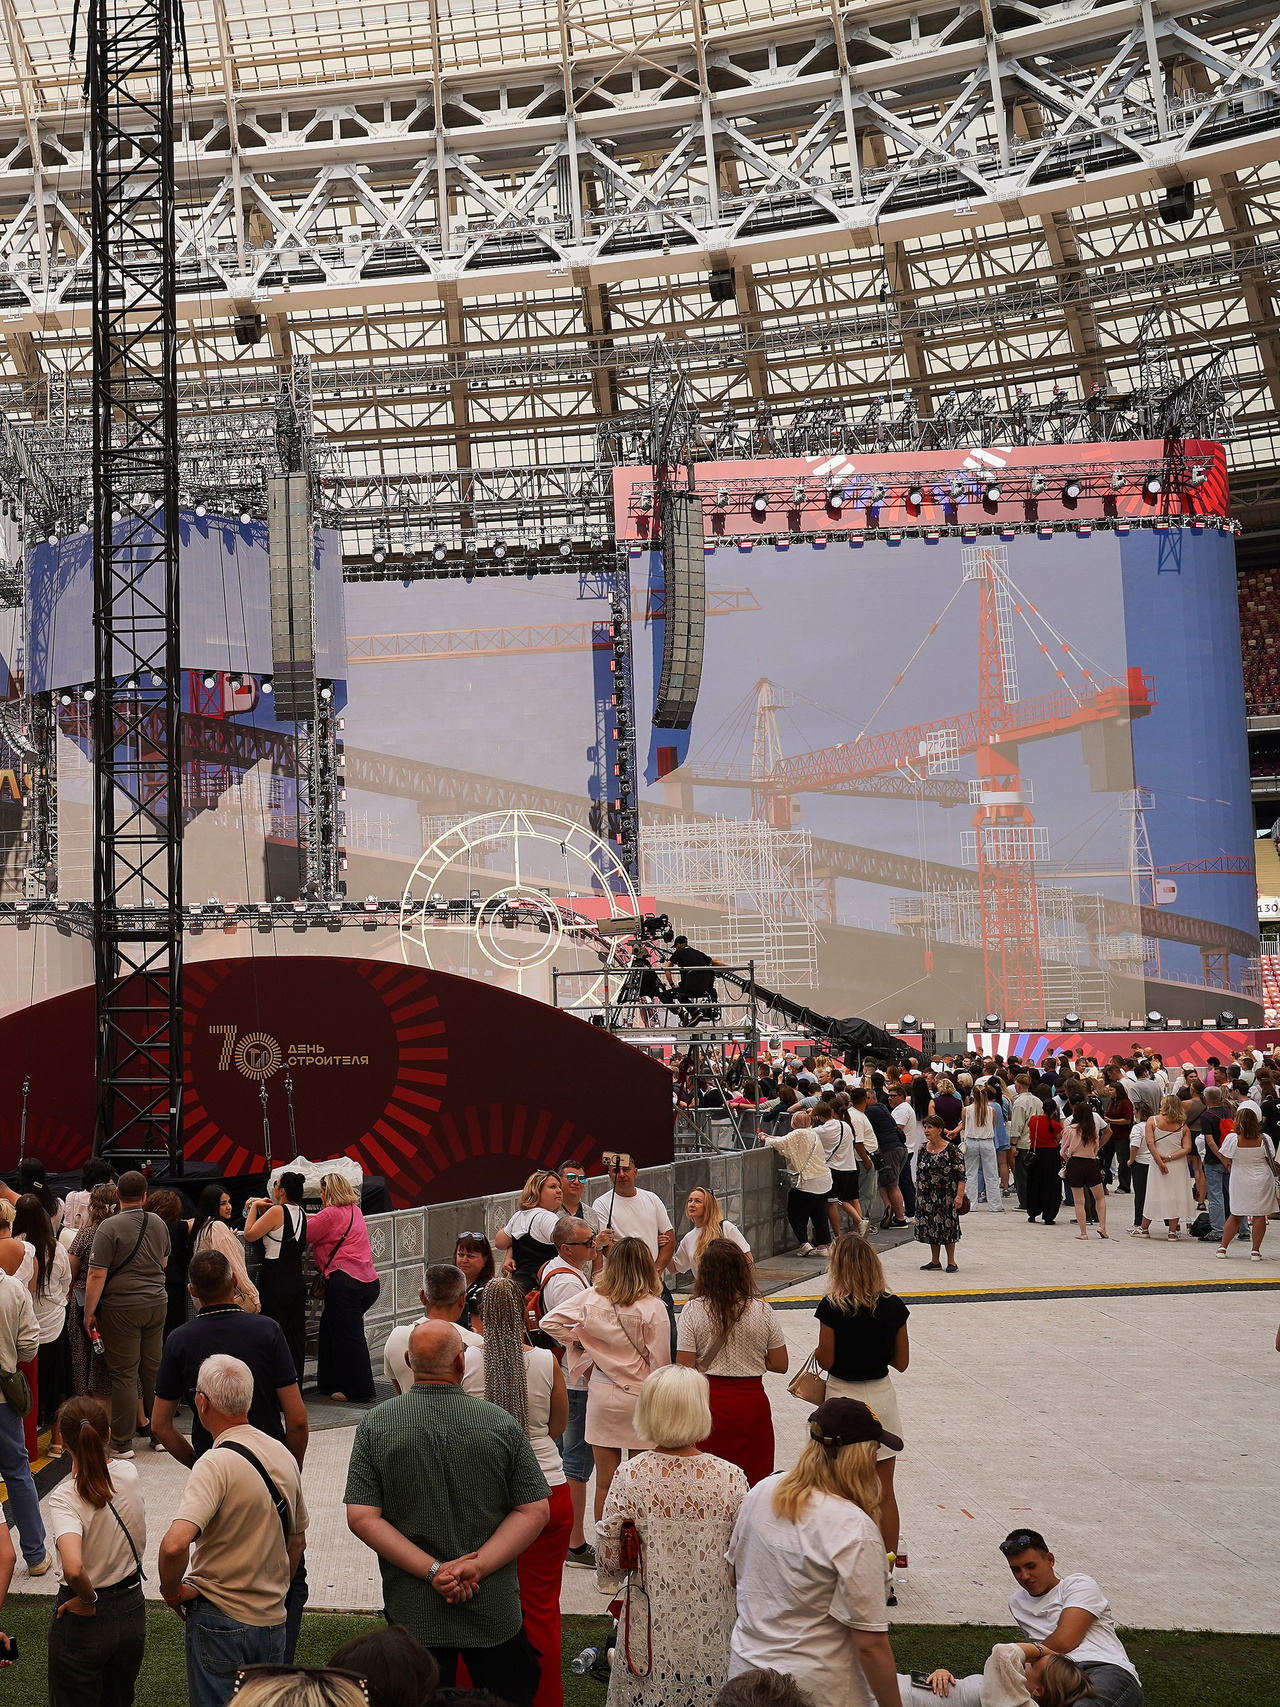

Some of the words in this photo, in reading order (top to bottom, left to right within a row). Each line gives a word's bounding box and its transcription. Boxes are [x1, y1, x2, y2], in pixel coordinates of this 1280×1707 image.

[208, 1025, 282, 1080] 70
[287, 1044, 325, 1054] ДЕНЬ
[287, 1056, 369, 1066] СТРОИТЕЛЯ
